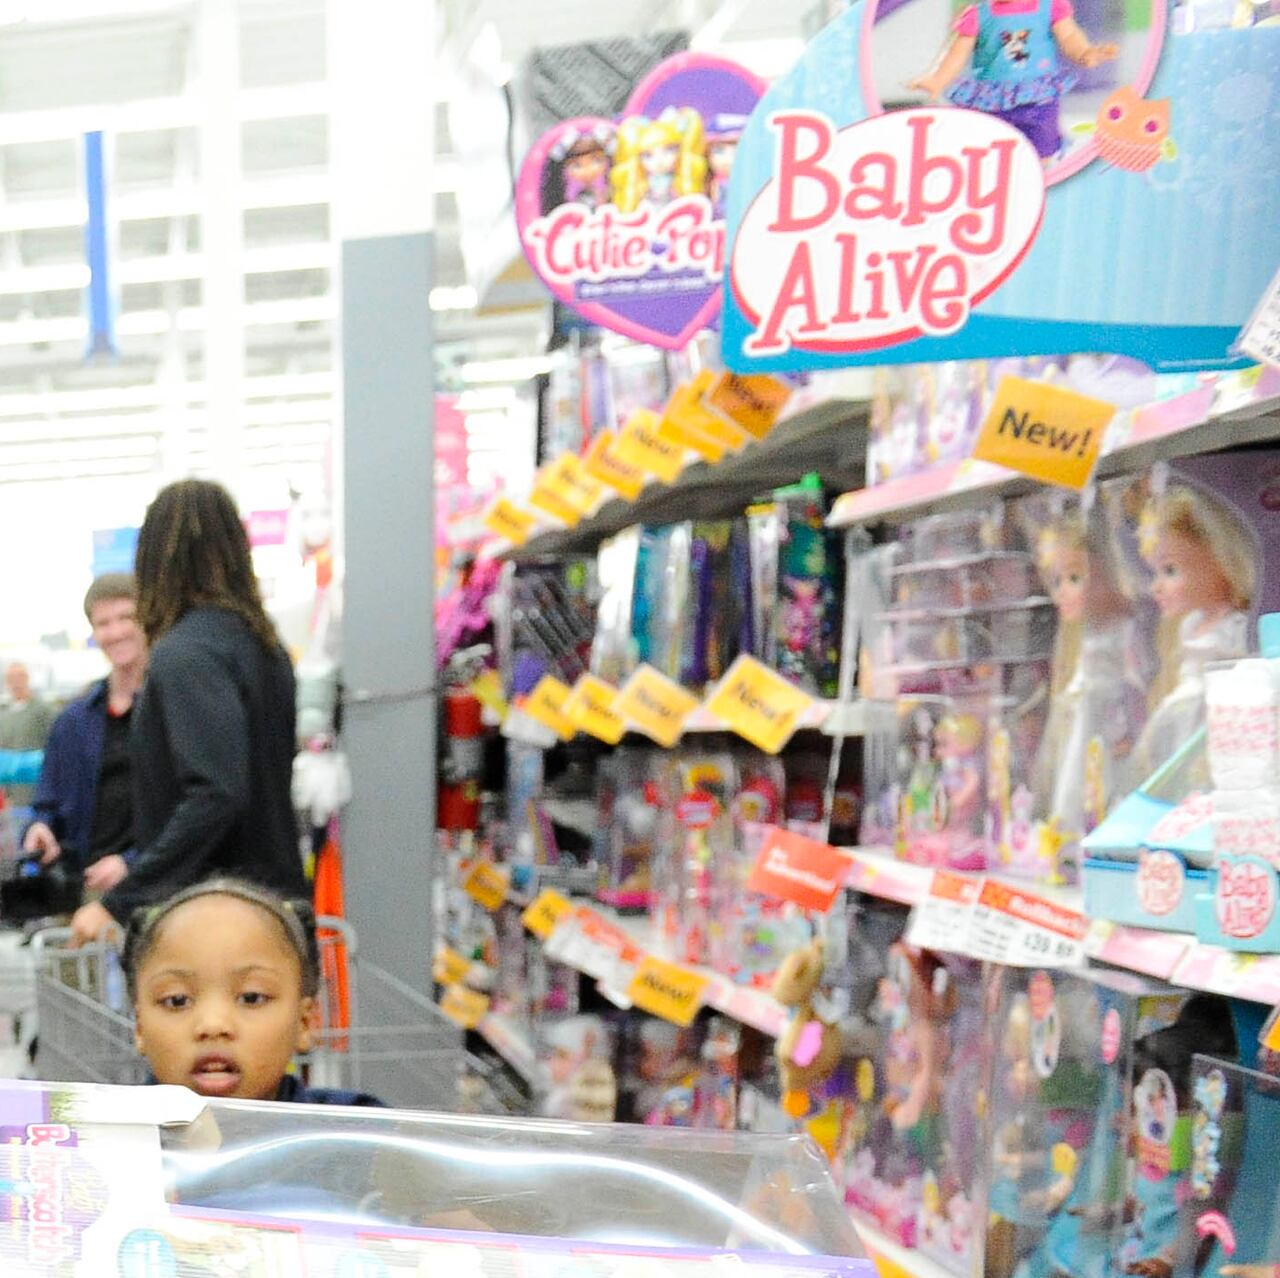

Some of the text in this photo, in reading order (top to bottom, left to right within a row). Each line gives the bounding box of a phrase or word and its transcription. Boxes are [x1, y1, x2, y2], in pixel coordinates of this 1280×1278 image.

[768, 113, 1019, 256] Baby
[533, 208, 649, 276] Cutie
[748, 235, 967, 354] Alive
[997, 403, 1094, 461] New!
